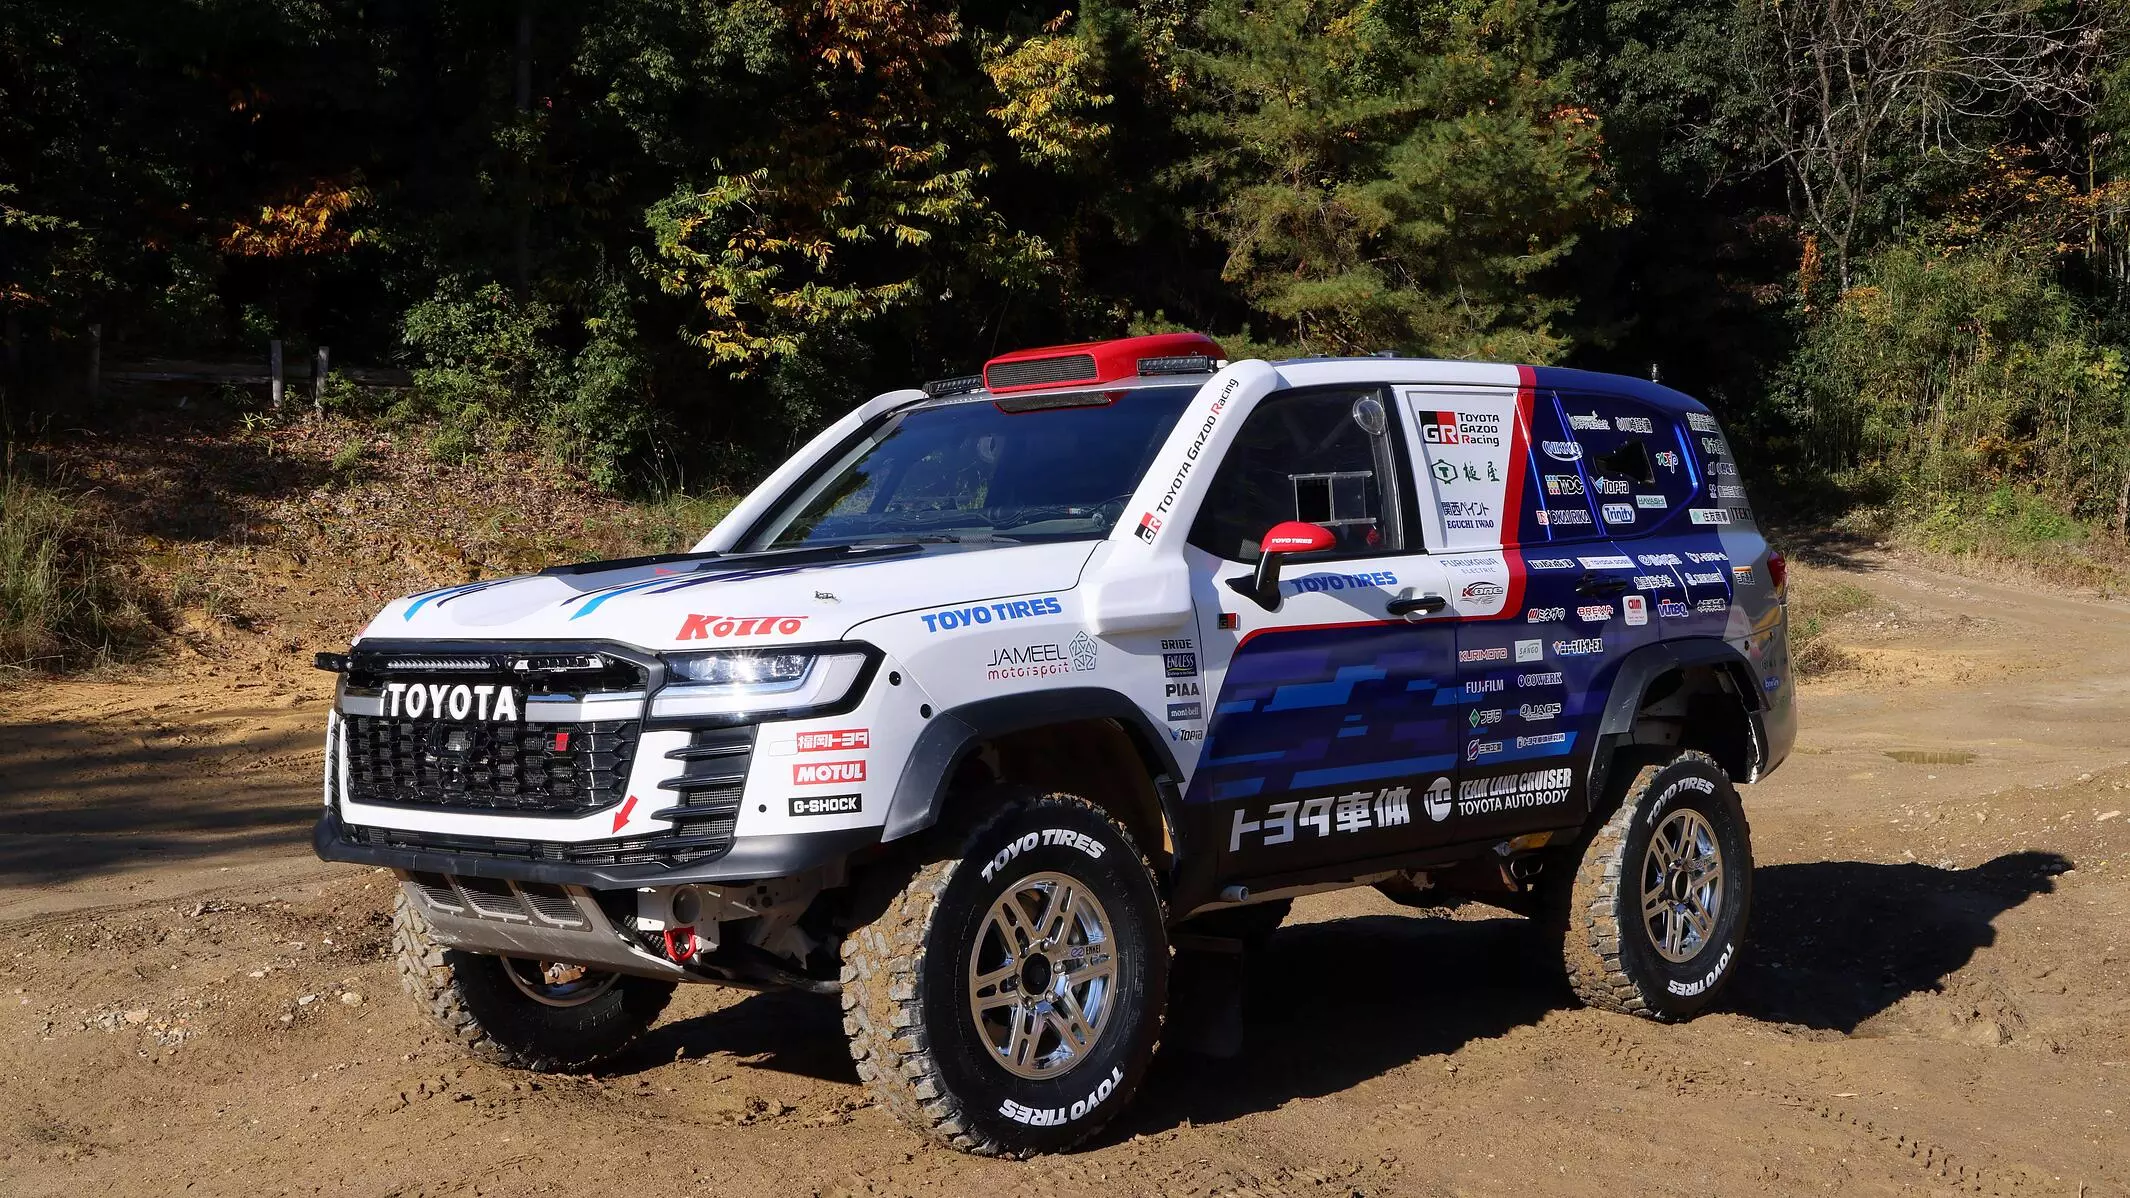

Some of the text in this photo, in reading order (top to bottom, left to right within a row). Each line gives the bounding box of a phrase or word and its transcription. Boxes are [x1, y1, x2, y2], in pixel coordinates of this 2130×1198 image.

[1458, 412, 1500, 423] TOYOTA
[1460, 423, 1498, 434] GAZOO
[1156, 461, 1192, 514] TOYOTA
[1187, 415, 1217, 461] GAZOO
[1211, 377, 1240, 415] Racing
[1462, 435, 1500, 447] Racing
[1603, 480, 1629, 494] Topia
[1441, 501, 1490, 516] 関西ペイント
[1604, 507, 1634, 522] Trinity
[1446, 519, 1495, 529] EGUCHI IWAO
[1440, 558, 1499, 568] FURUKAWA
[1461, 567, 1497, 575] ELECTRIC
[1291, 571, 1398, 594] TOYO TIRES
[920, 596, 1063, 633] TOYO TIRES
[1577, 605, 1613, 617] BREXA
[1160, 639, 1193, 650] BRIDE
[987, 644, 1068, 667] JAMEEL
[1166, 654, 1194, 668] ENDLESS
[1458, 648, 1508, 663] KURIMOTO
[988, 661, 1070, 681] motorsport
[1165, 682, 1200, 697] PIAA
[1466, 679, 1504, 694] FUJIFILM
[387, 682, 518, 721] TOYOTA
[1531, 703, 1561, 715] JAOS
[1480, 709, 1502, 724] フジタ
[797, 731, 868, 749] 福岡トヨタ
[1180, 729, 1203, 741] Topia
[796, 763, 863, 783] MOTUL
[1458, 779, 1490, 801] TEAM
[1489, 774, 1518, 796] LAND
[1518, 768, 1573, 792] CRUISER
[793, 797, 857, 813] G-SHOCK
[1458, 789, 1569, 817] TOYOTA AUTO BODY
[1646, 776, 1716, 825] TOYO TIRES
[1229, 786, 1412, 853] トヨタ車体
[980, 828, 1107, 884] TOYO TIRES
[1667, 942, 1735, 997] TOYO TIRES
[998, 1066, 1125, 1128] TOYO TIRES
